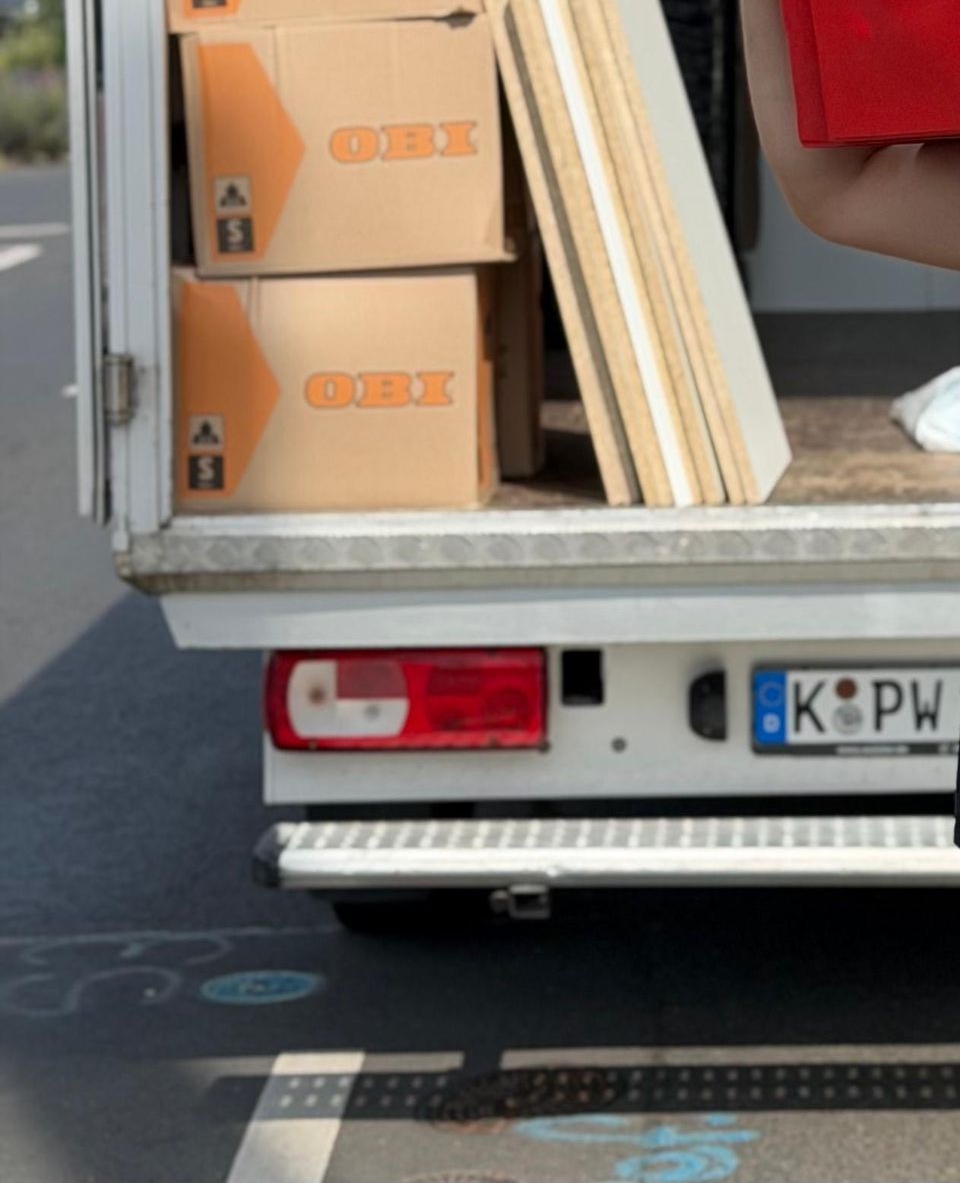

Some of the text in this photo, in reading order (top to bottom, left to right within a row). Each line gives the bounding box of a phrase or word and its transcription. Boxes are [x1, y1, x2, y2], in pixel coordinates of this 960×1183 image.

[329, 121, 478, 163] OBI
[227, 220, 243, 243] S
[305, 371, 455, 409] OBI
[197, 457, 215, 481] S
[794, 679, 943, 733] K PW
